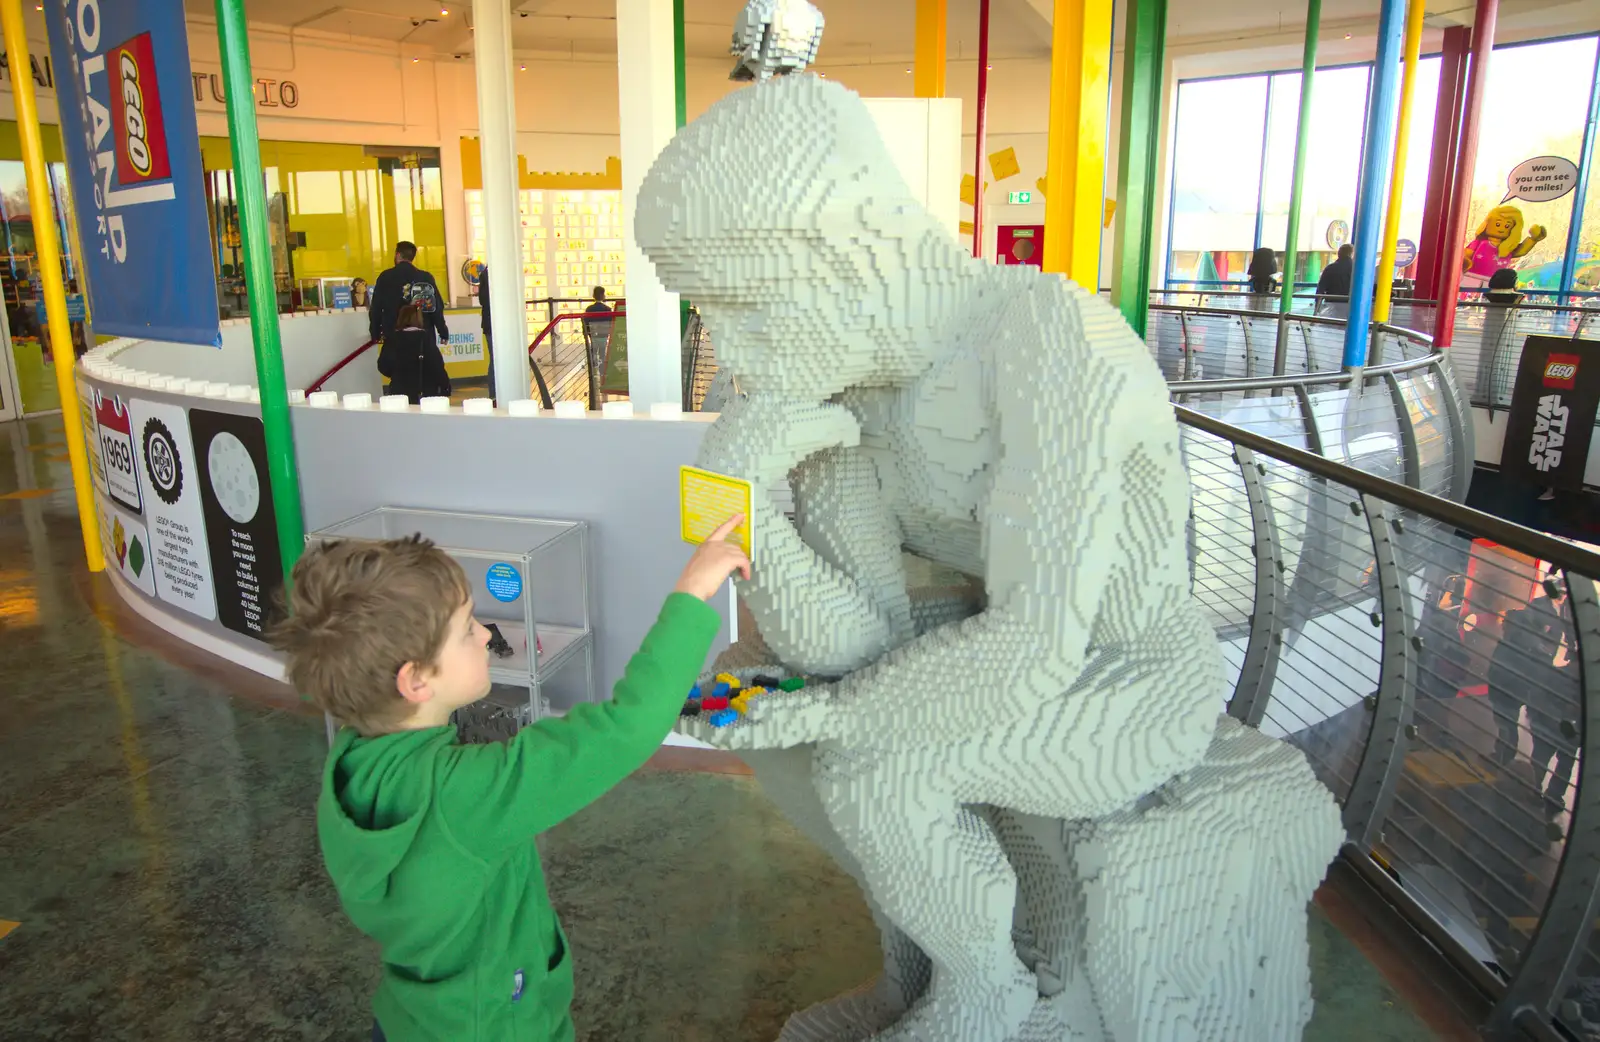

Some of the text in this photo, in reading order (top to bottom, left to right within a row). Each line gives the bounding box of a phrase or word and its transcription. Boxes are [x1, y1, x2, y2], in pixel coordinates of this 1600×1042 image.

[121, 54, 150, 173] LEGO
[1515, 175, 1533, 184] you
[449, 333, 474, 344] BRING
[453, 344, 464, 355] TO
[465, 343, 481, 354] LIFE
[1546, 364, 1575, 379] LEGO
[1528, 394, 1555, 471] WARS
[1543, 394, 1570, 472] STAR
[103, 435, 131, 475] 1969
[231, 529, 251, 541] To reach
[231, 539, 254, 552] the moon
[232, 550, 256, 562] you would
[239, 562, 252, 571] need
[236, 570, 242, 578] to
[242, 571, 254, 582] build
[237, 580, 254, 591] column
[241, 591, 258, 602] around
[248, 602, 262, 613] billion
